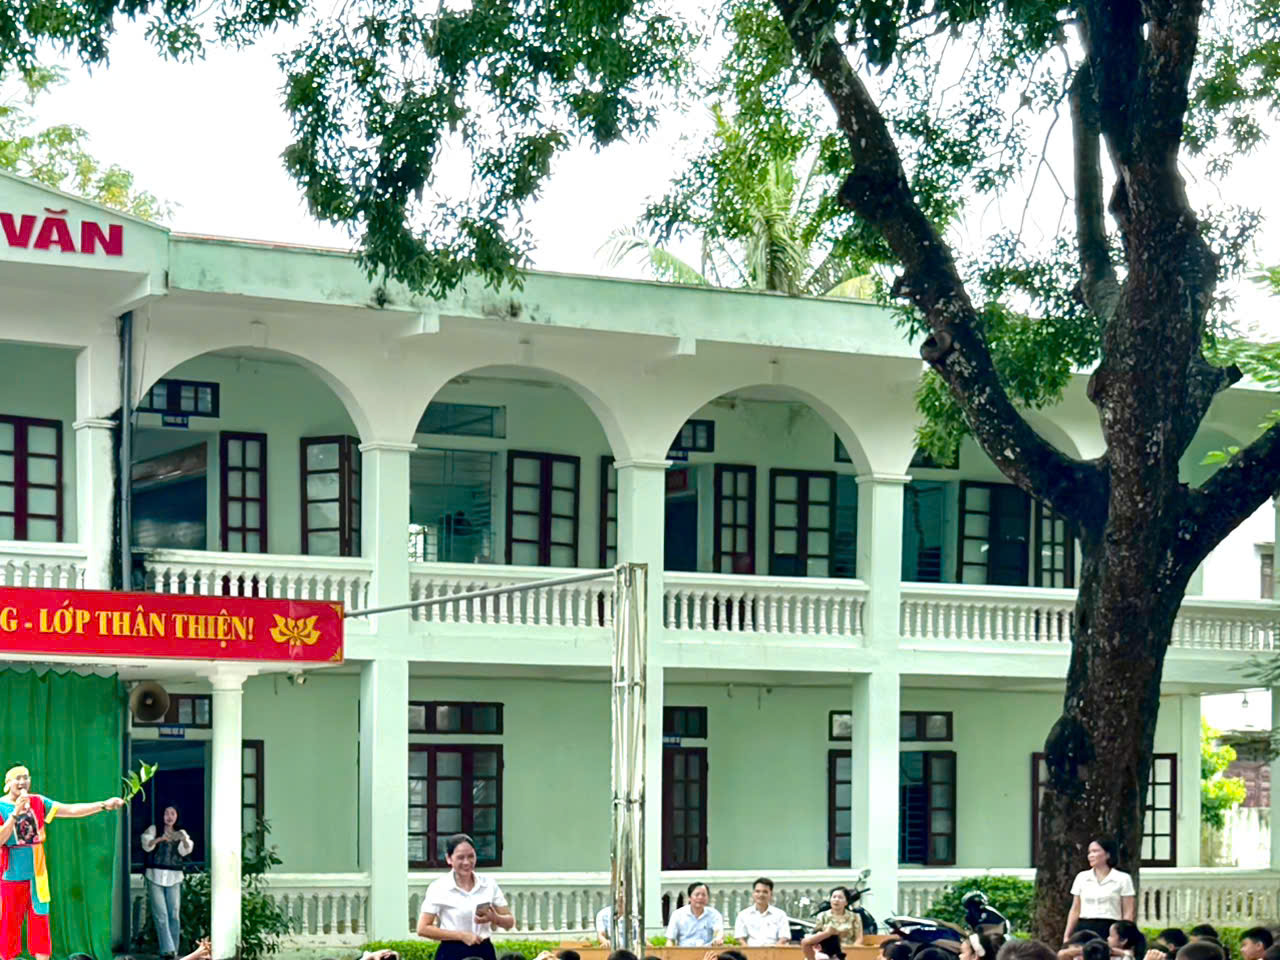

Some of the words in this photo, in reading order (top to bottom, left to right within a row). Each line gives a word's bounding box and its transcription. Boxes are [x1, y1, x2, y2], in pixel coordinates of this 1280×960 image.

[0, 207, 124, 257] VĂN
[39, 600, 90, 635] LỚP
[95, 605, 166, 638] THÂN
[171, 609, 254, 649] THIỆN!
